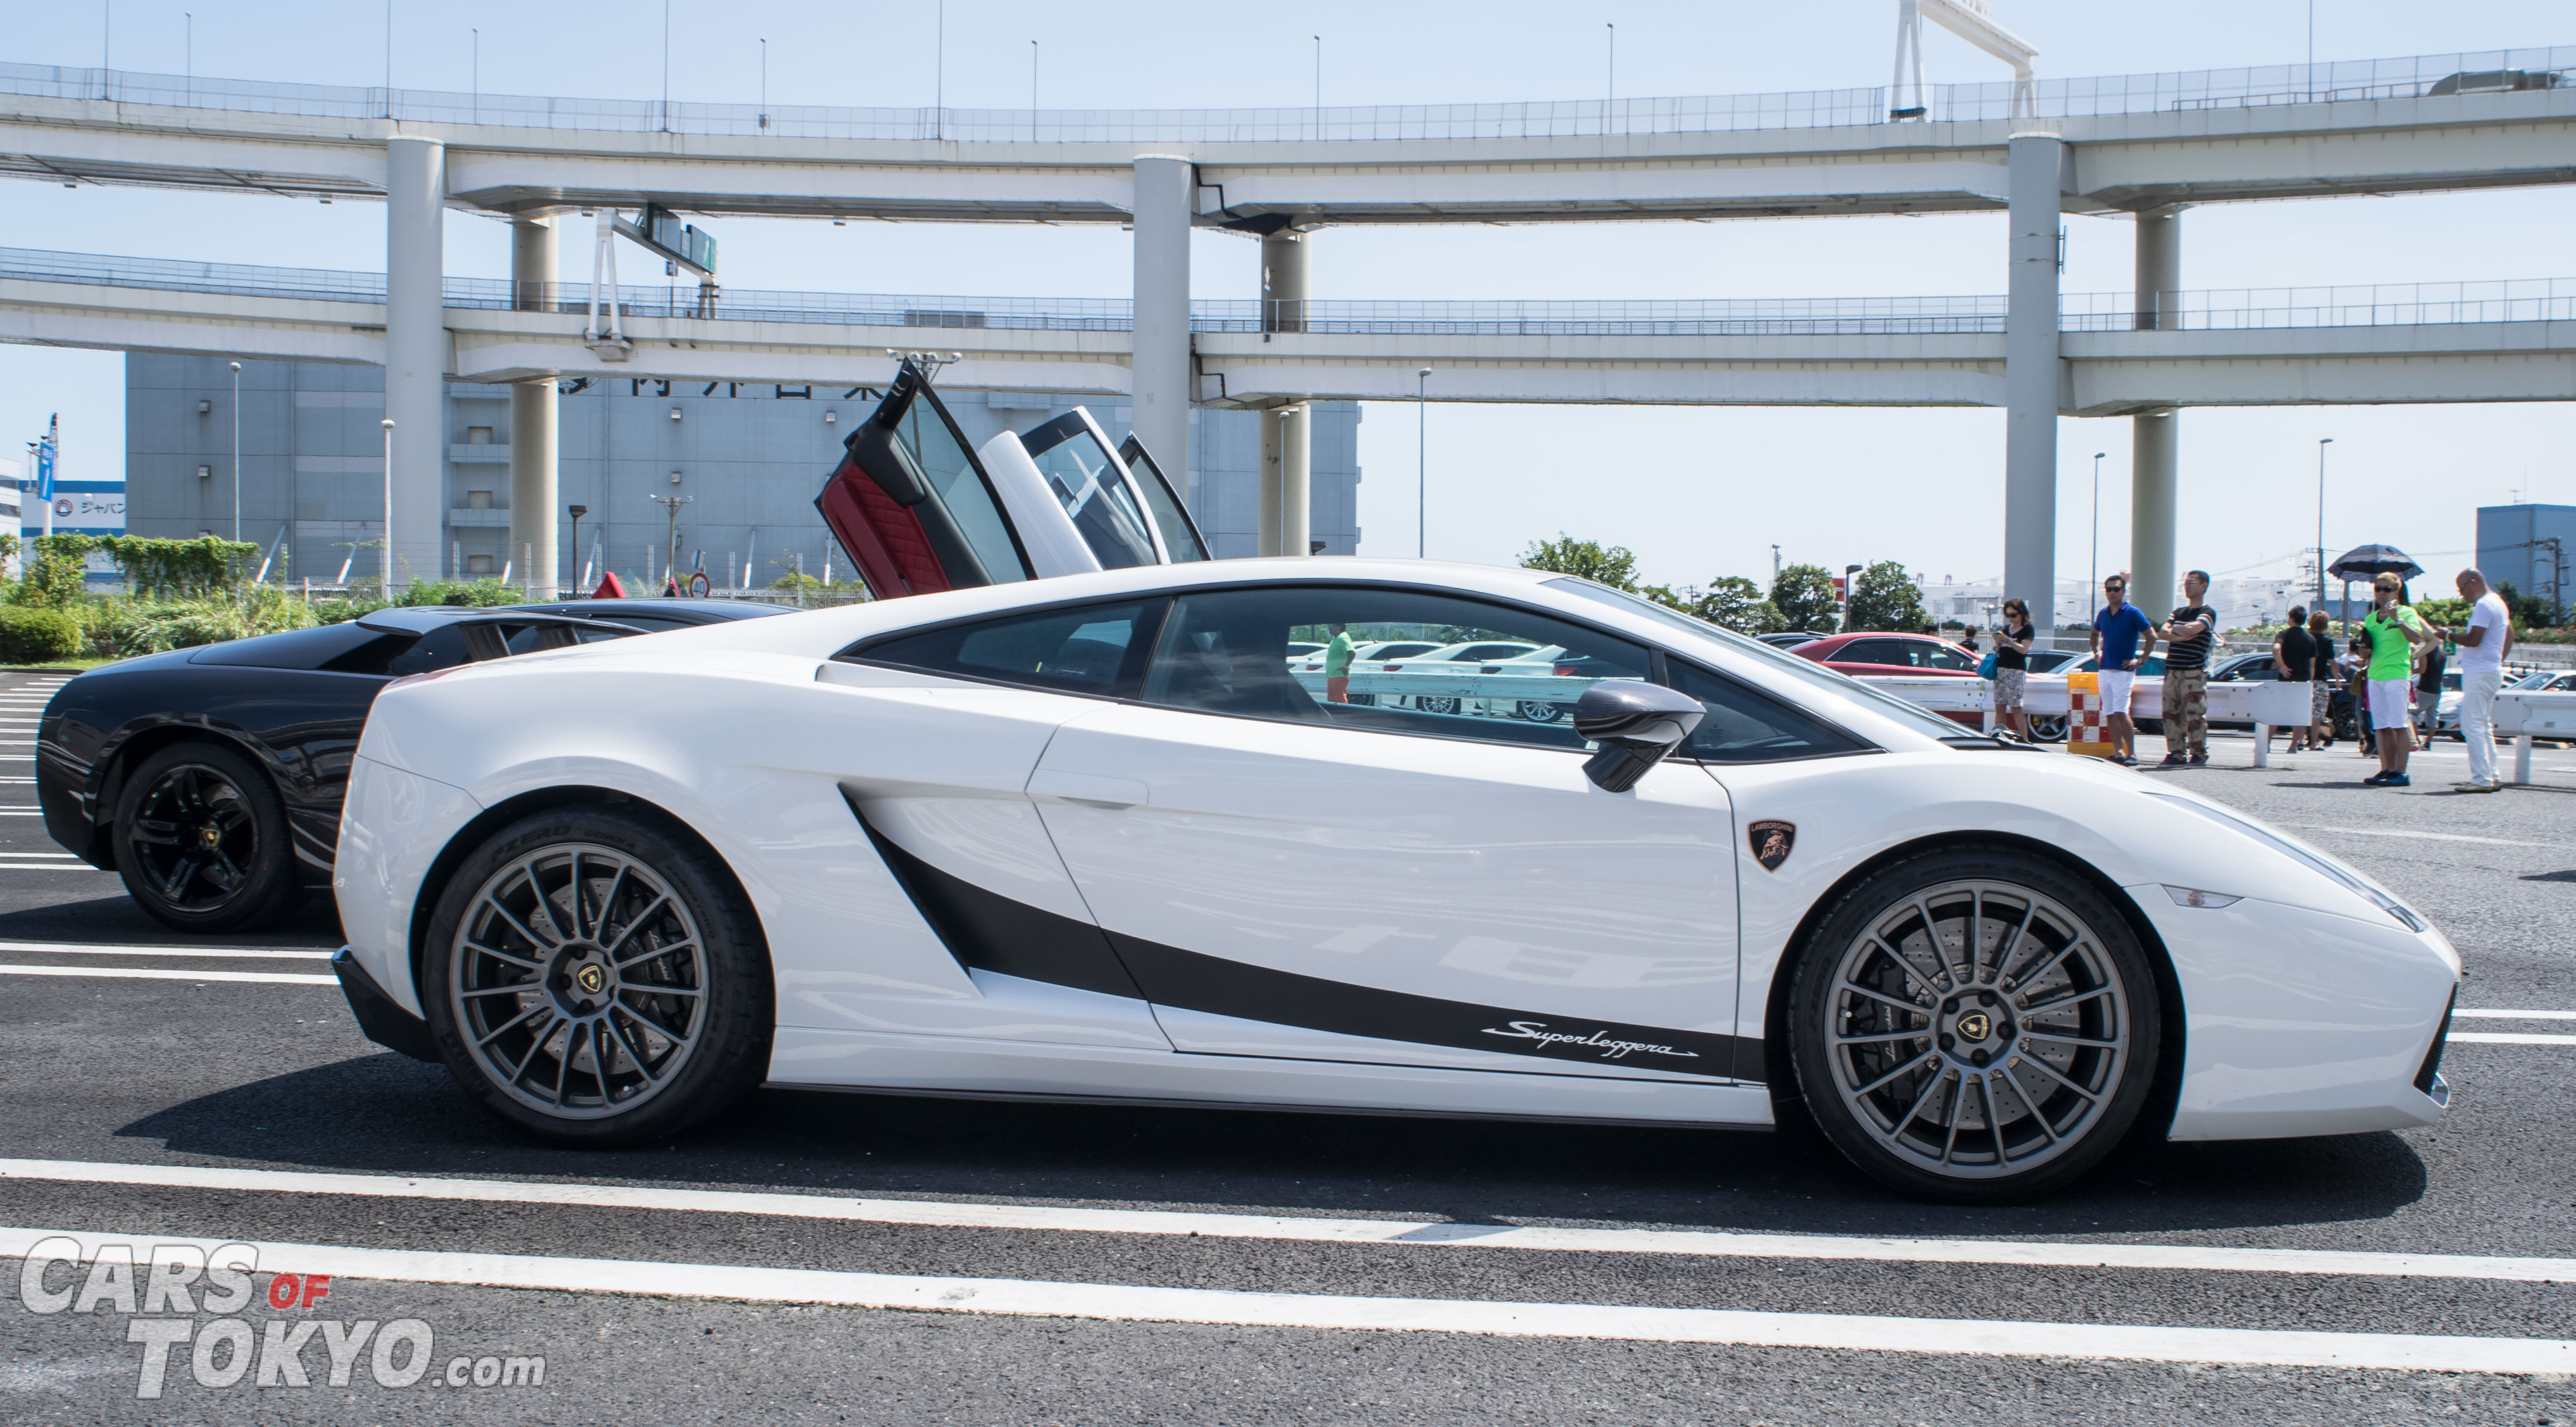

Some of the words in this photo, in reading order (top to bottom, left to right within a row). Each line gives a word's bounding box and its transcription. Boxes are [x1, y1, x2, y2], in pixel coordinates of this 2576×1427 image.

[693, 581, 705, 594] 40
[1751, 823, 1794, 832] LAMBORGHINI
[1481, 1021, 1699, 1058] Superleggera
